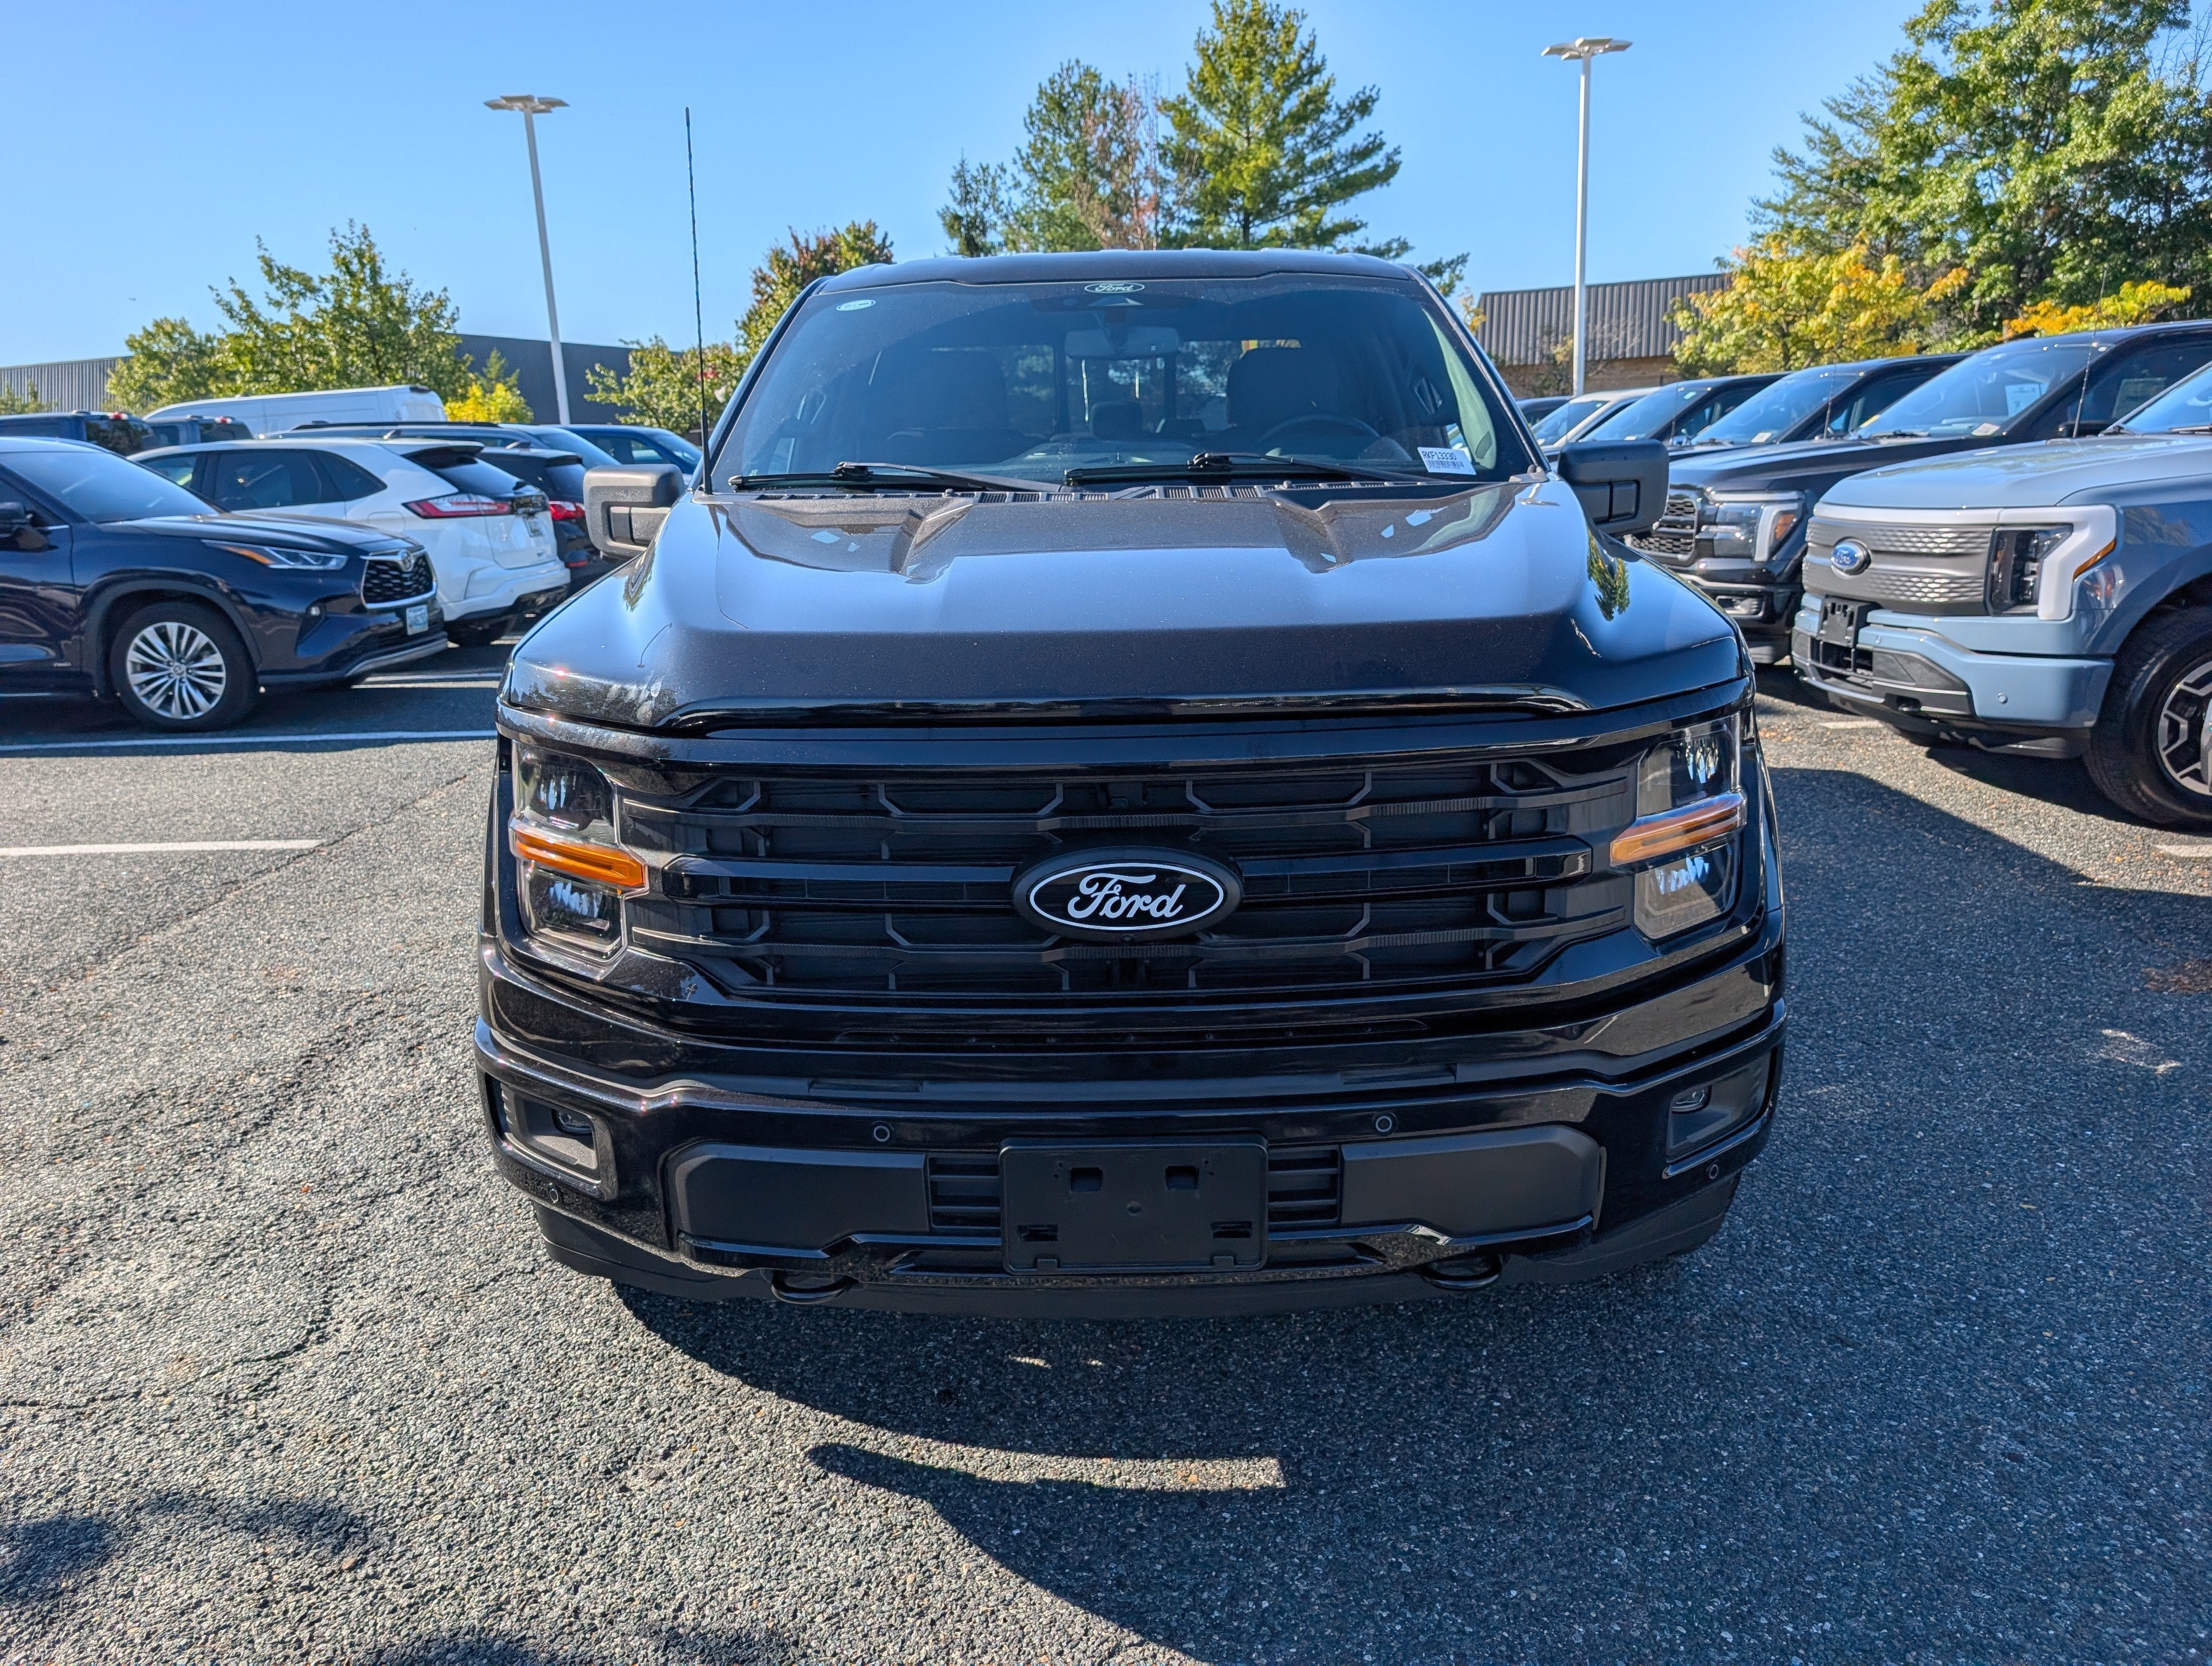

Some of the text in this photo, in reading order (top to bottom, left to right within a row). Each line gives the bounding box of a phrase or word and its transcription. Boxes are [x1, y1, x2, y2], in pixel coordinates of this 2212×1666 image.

[1095, 283, 1134, 291] Ford
[1422, 451, 1457, 460] RKF13330
[1068, 873, 1186, 919] Ford
